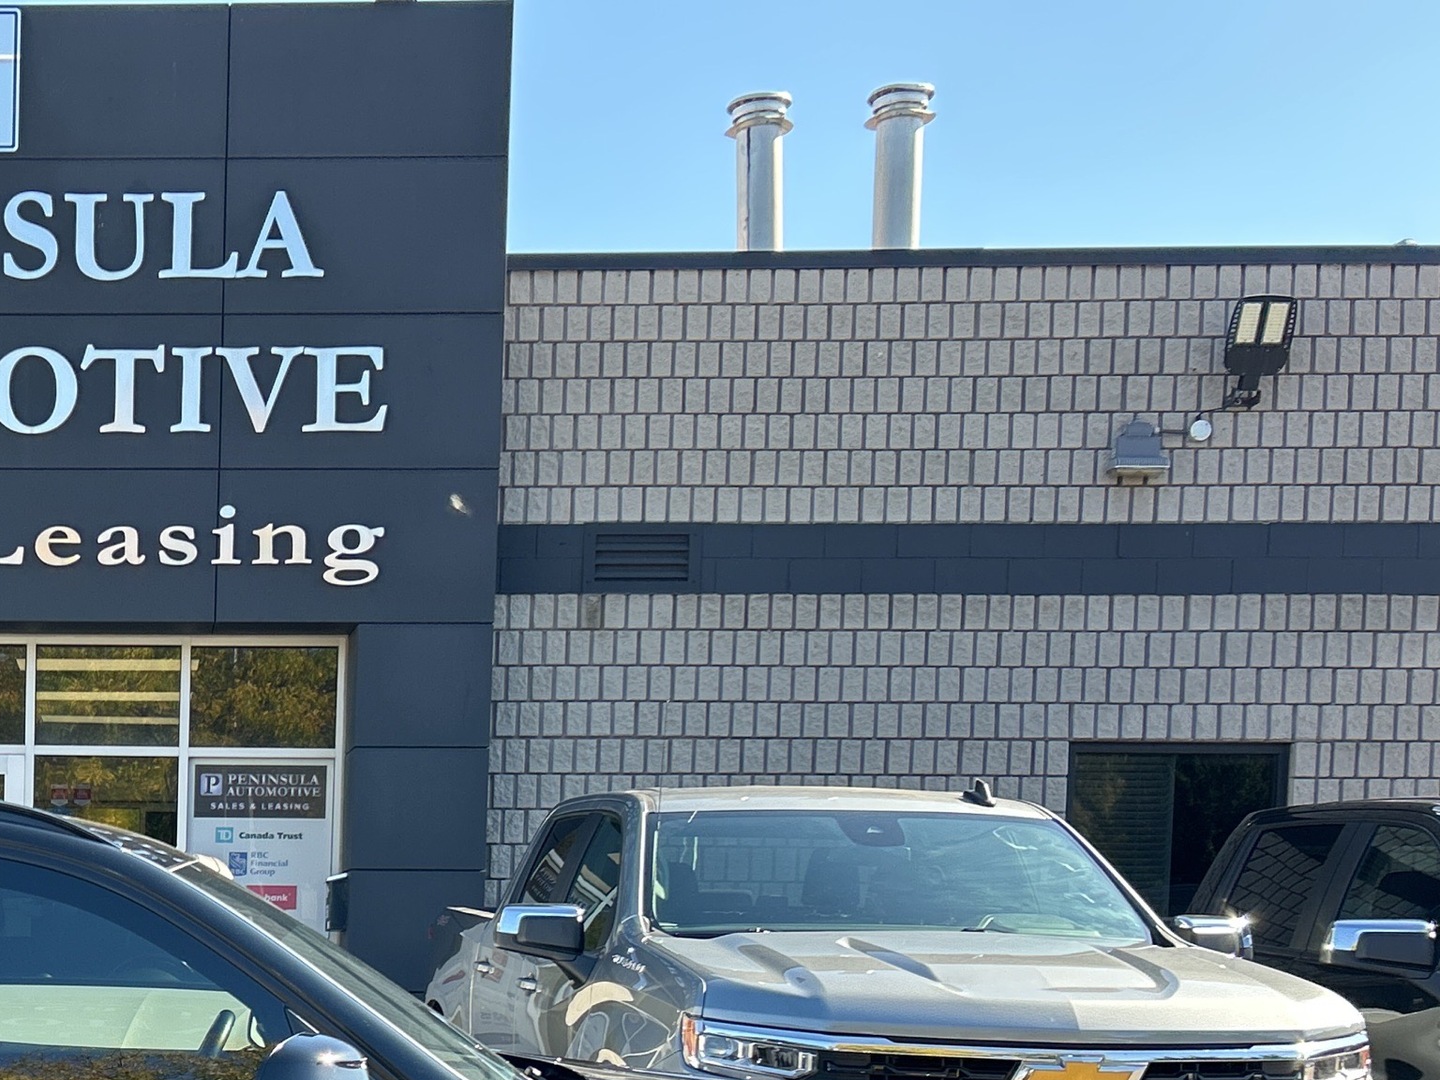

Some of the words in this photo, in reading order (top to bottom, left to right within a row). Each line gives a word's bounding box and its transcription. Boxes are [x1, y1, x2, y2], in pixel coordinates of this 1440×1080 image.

[205, 776, 220, 794] P
[227, 774, 319, 786] PENINSULA
[226, 787, 321, 797] AUTOMOTIVE
[210, 802, 245, 810] SALES
[261, 803, 310, 811] LEASING
[218, 830, 232, 841] TD
[239, 832, 274, 840] Canada
[277, 832, 303, 840] Trust
[251, 851, 269, 859] RBC
[250, 868, 276, 877] Group
